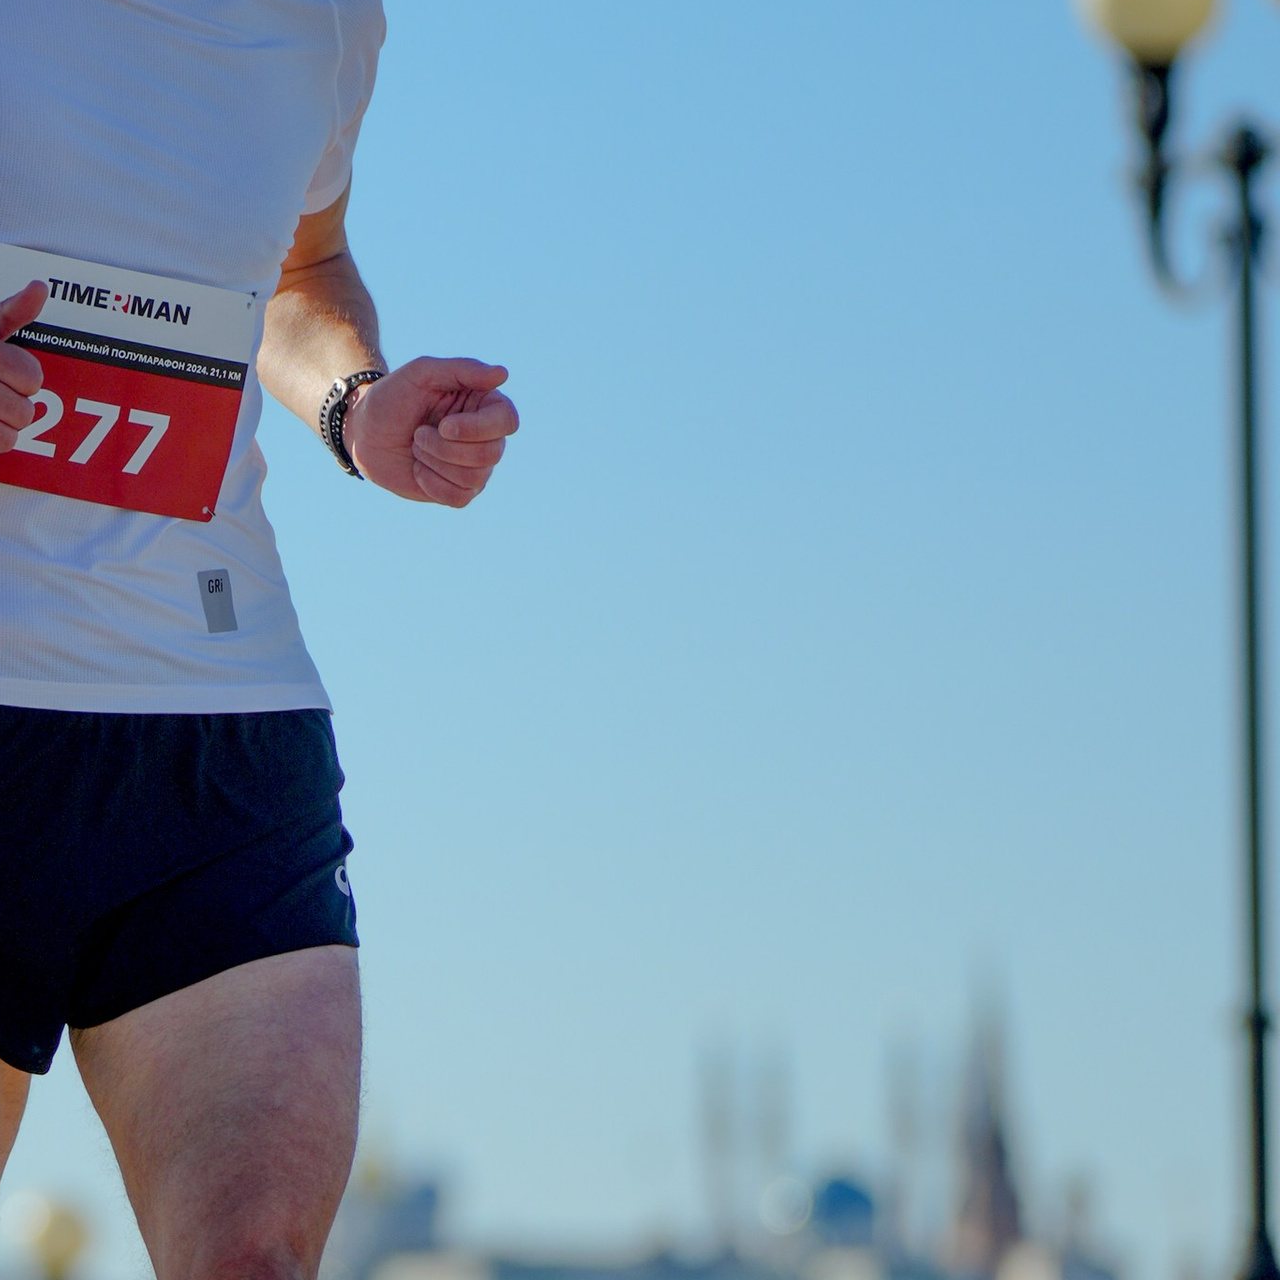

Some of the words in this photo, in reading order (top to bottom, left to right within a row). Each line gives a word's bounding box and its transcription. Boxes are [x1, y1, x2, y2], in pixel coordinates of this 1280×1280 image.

[20, 329, 110, 356] НАЦИОНАЛЬНЫЙ
[110, 348, 186, 371] ПОЛУМАРАФОН
[186, 363, 209, 376] 2024.
[209, 367, 227, 379] 21,1
[228, 371, 242, 381] КМ
[12, 388, 171, 475] 277
[207, 578, 224, 594] GRi
